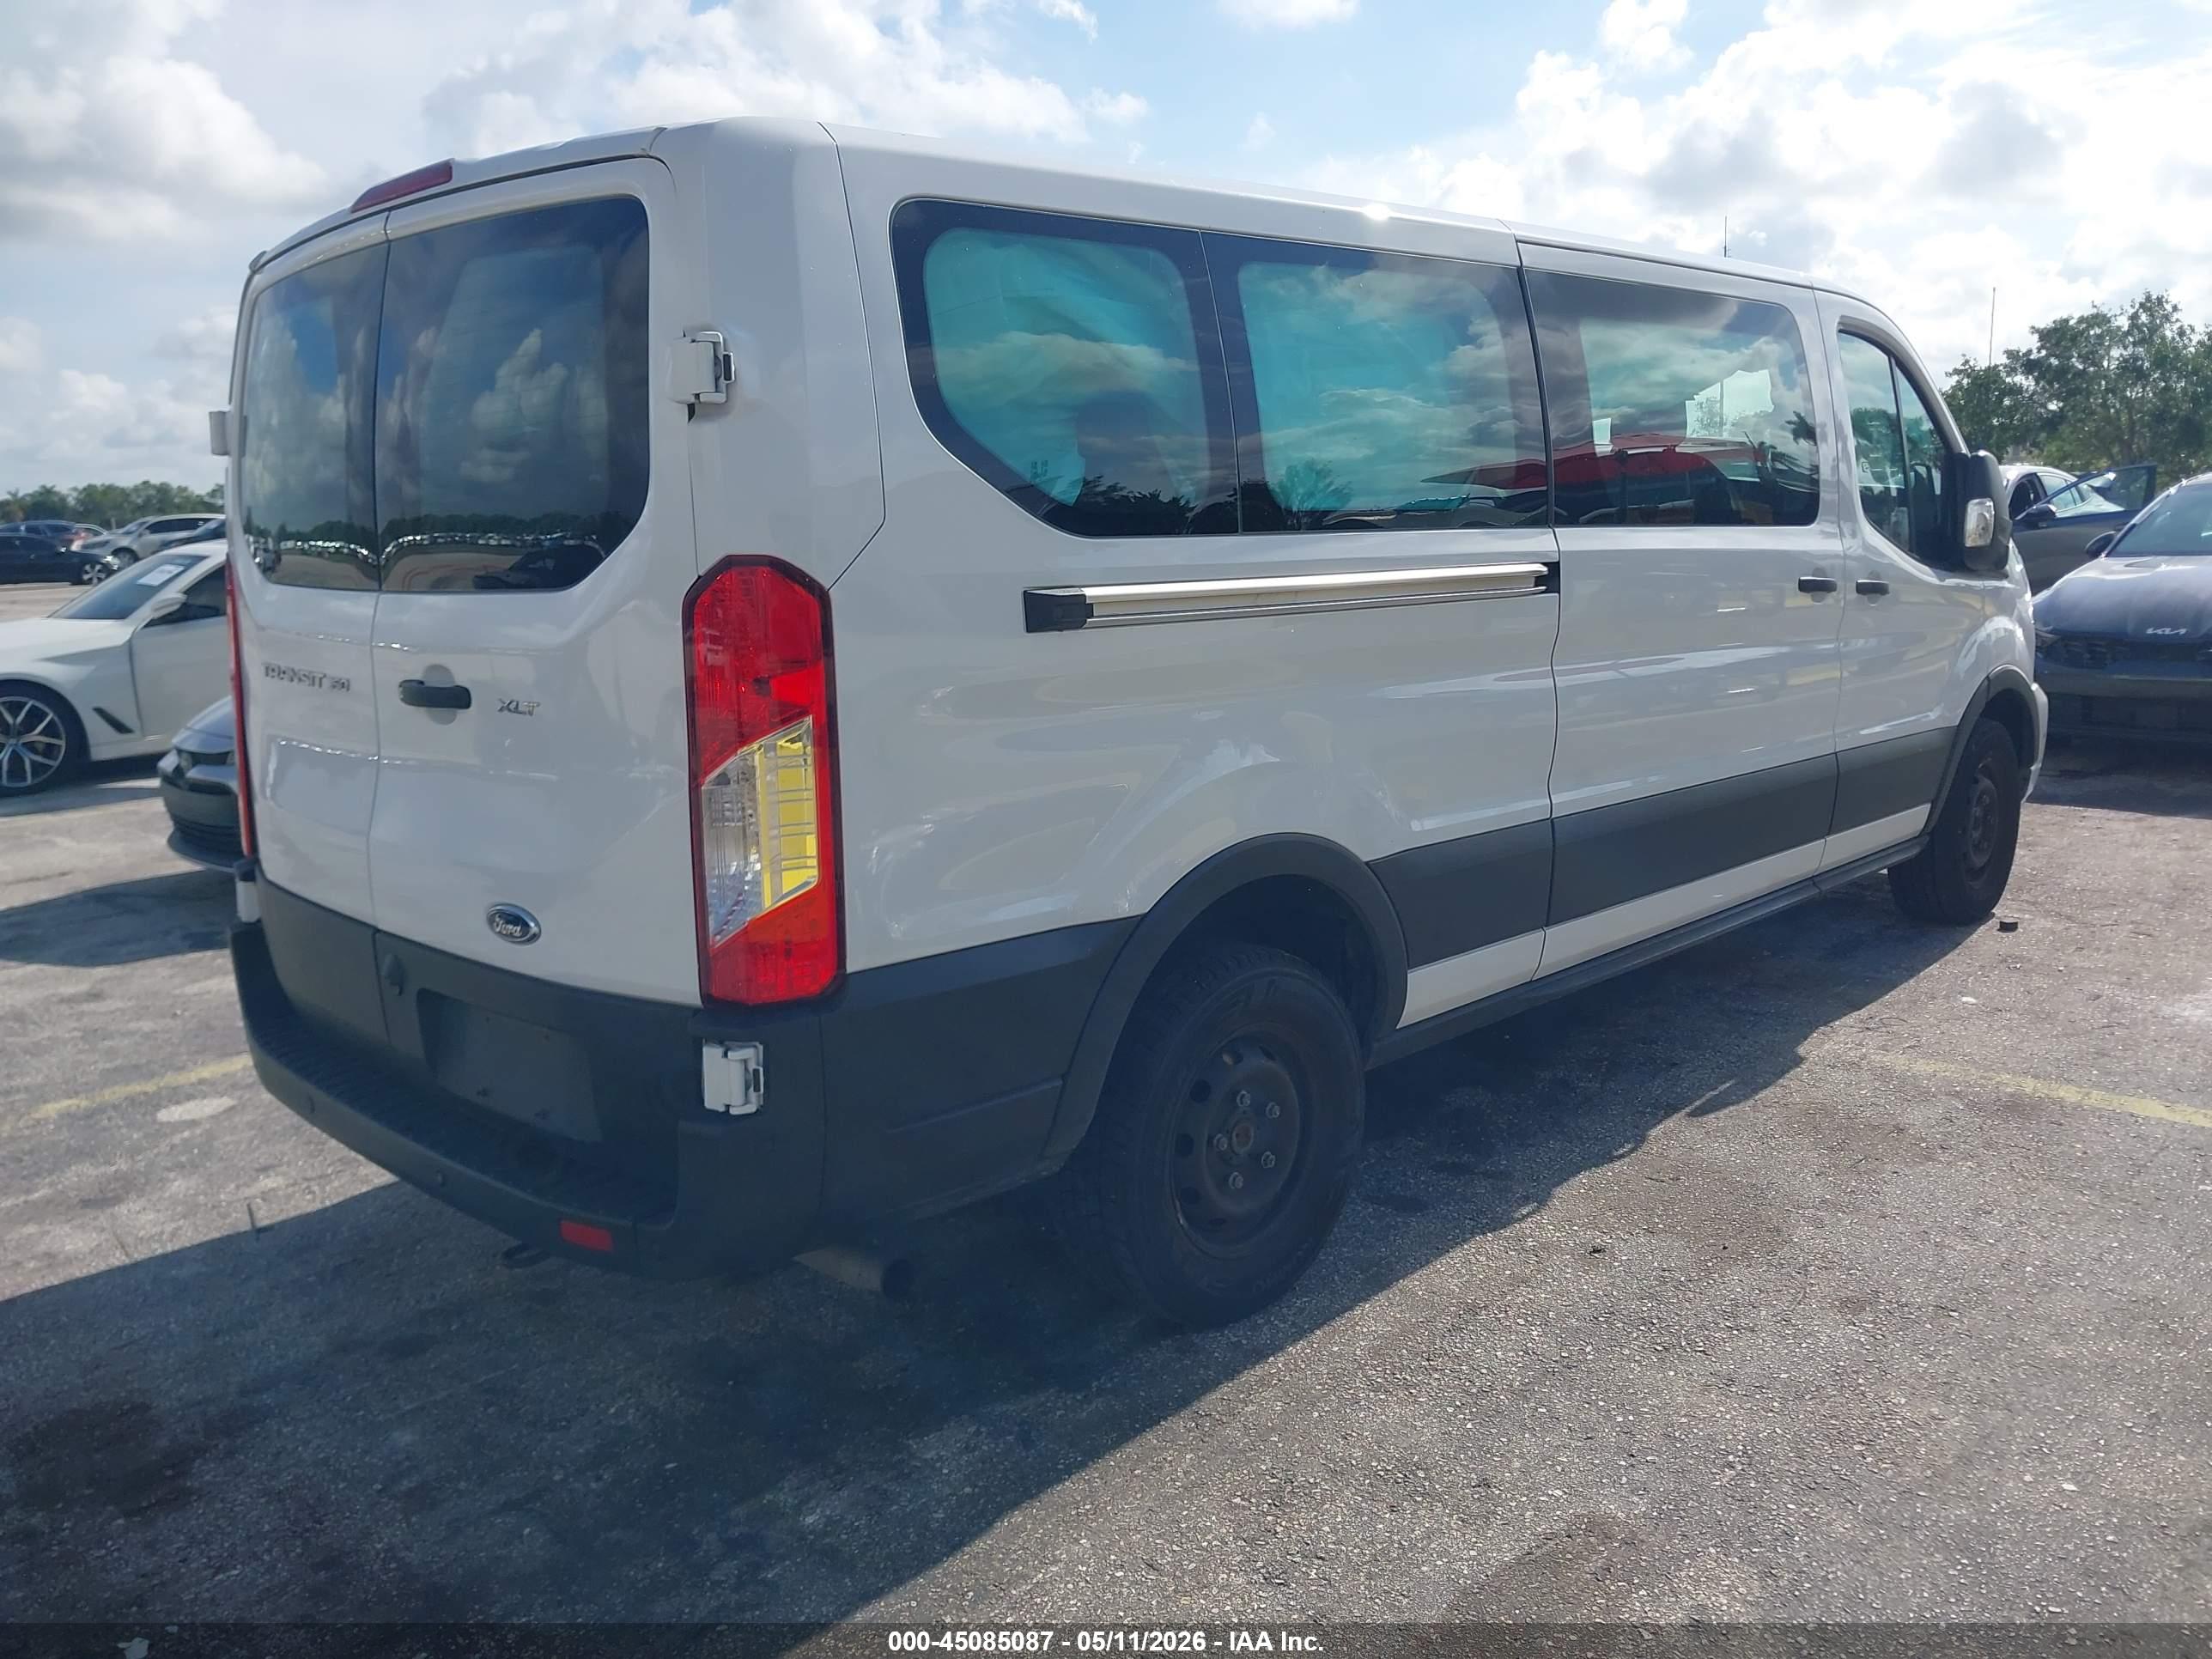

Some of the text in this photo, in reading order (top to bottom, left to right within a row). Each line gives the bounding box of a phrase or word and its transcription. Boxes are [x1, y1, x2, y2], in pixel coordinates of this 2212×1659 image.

[261, 661, 327, 689] TRANSIT
[496, 697, 541, 716] XLT
[494, 913, 524, 937] Ford
